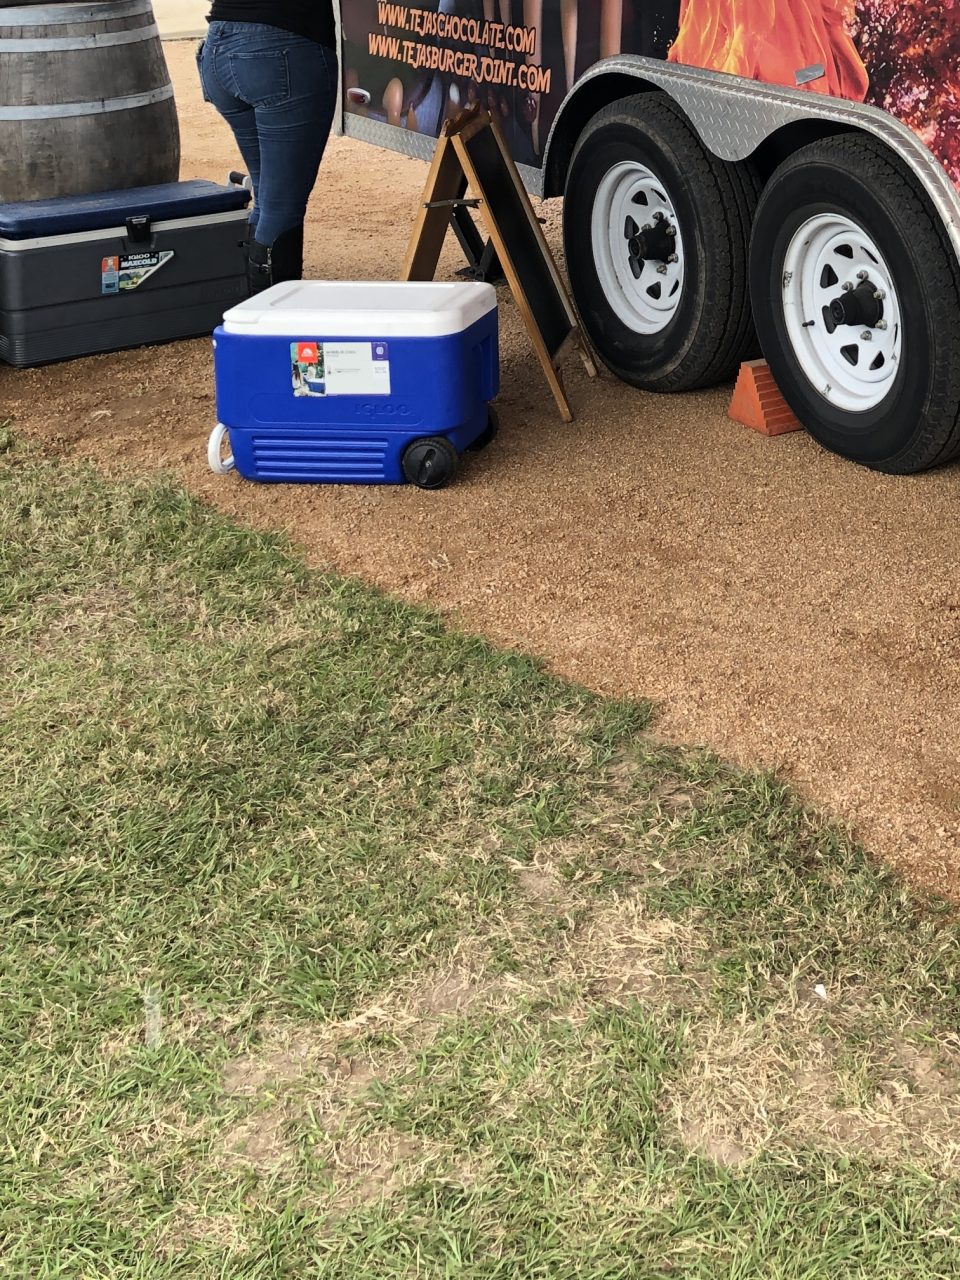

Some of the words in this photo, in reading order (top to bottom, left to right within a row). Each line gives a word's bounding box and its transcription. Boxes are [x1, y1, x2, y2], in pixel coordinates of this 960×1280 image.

[378, 2, 536, 55] WWW.TEJASCHOCOLATE.COM
[368, 32, 551, 94] WWW.TEJASBURGERJOINT.COM
[120, 258, 158, 268] MAXCOLD
